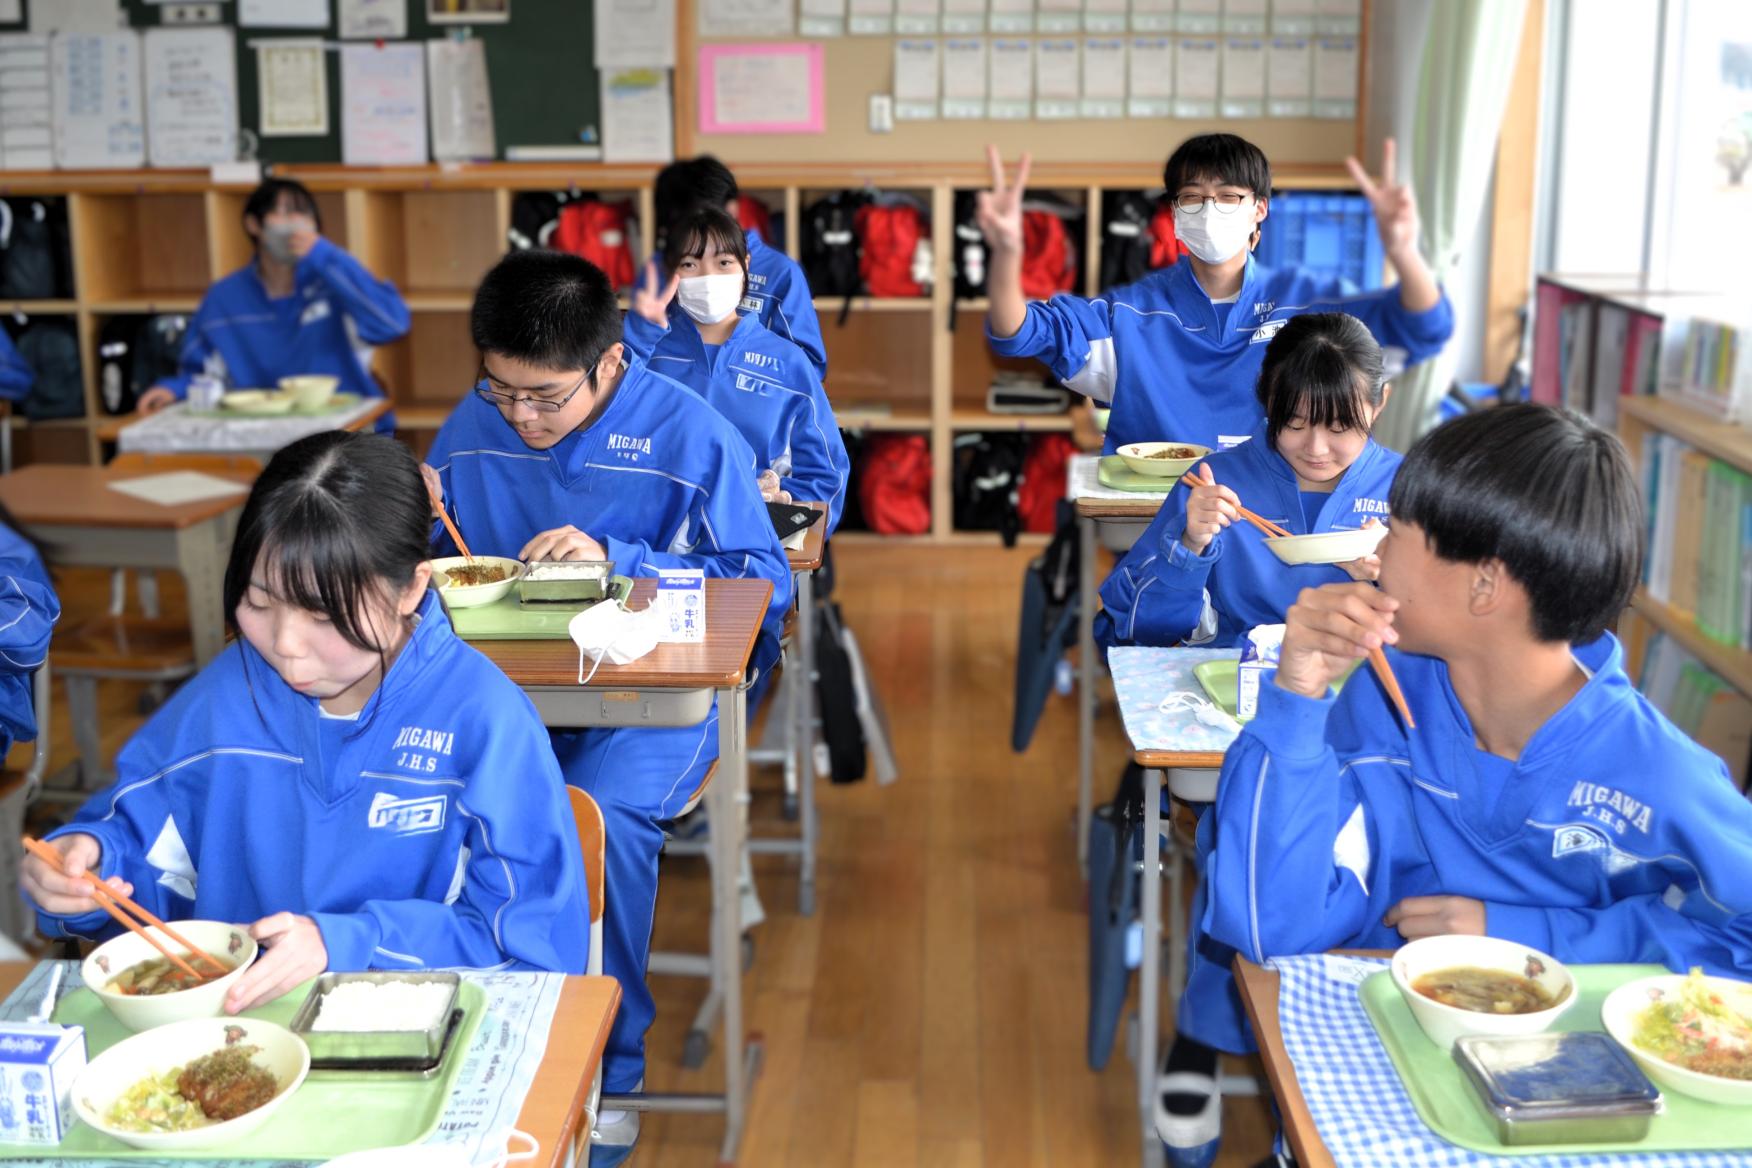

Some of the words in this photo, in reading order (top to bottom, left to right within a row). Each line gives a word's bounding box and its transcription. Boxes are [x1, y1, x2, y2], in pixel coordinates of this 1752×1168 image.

[684, 608, 695, 629] 牛乳
[397, 752, 437, 773] J.H.S
[1567, 780, 1653, 834] MIGAWA
[1581, 805, 1627, 835] J.H.S
[25, 1094, 44, 1125] 牛乳
